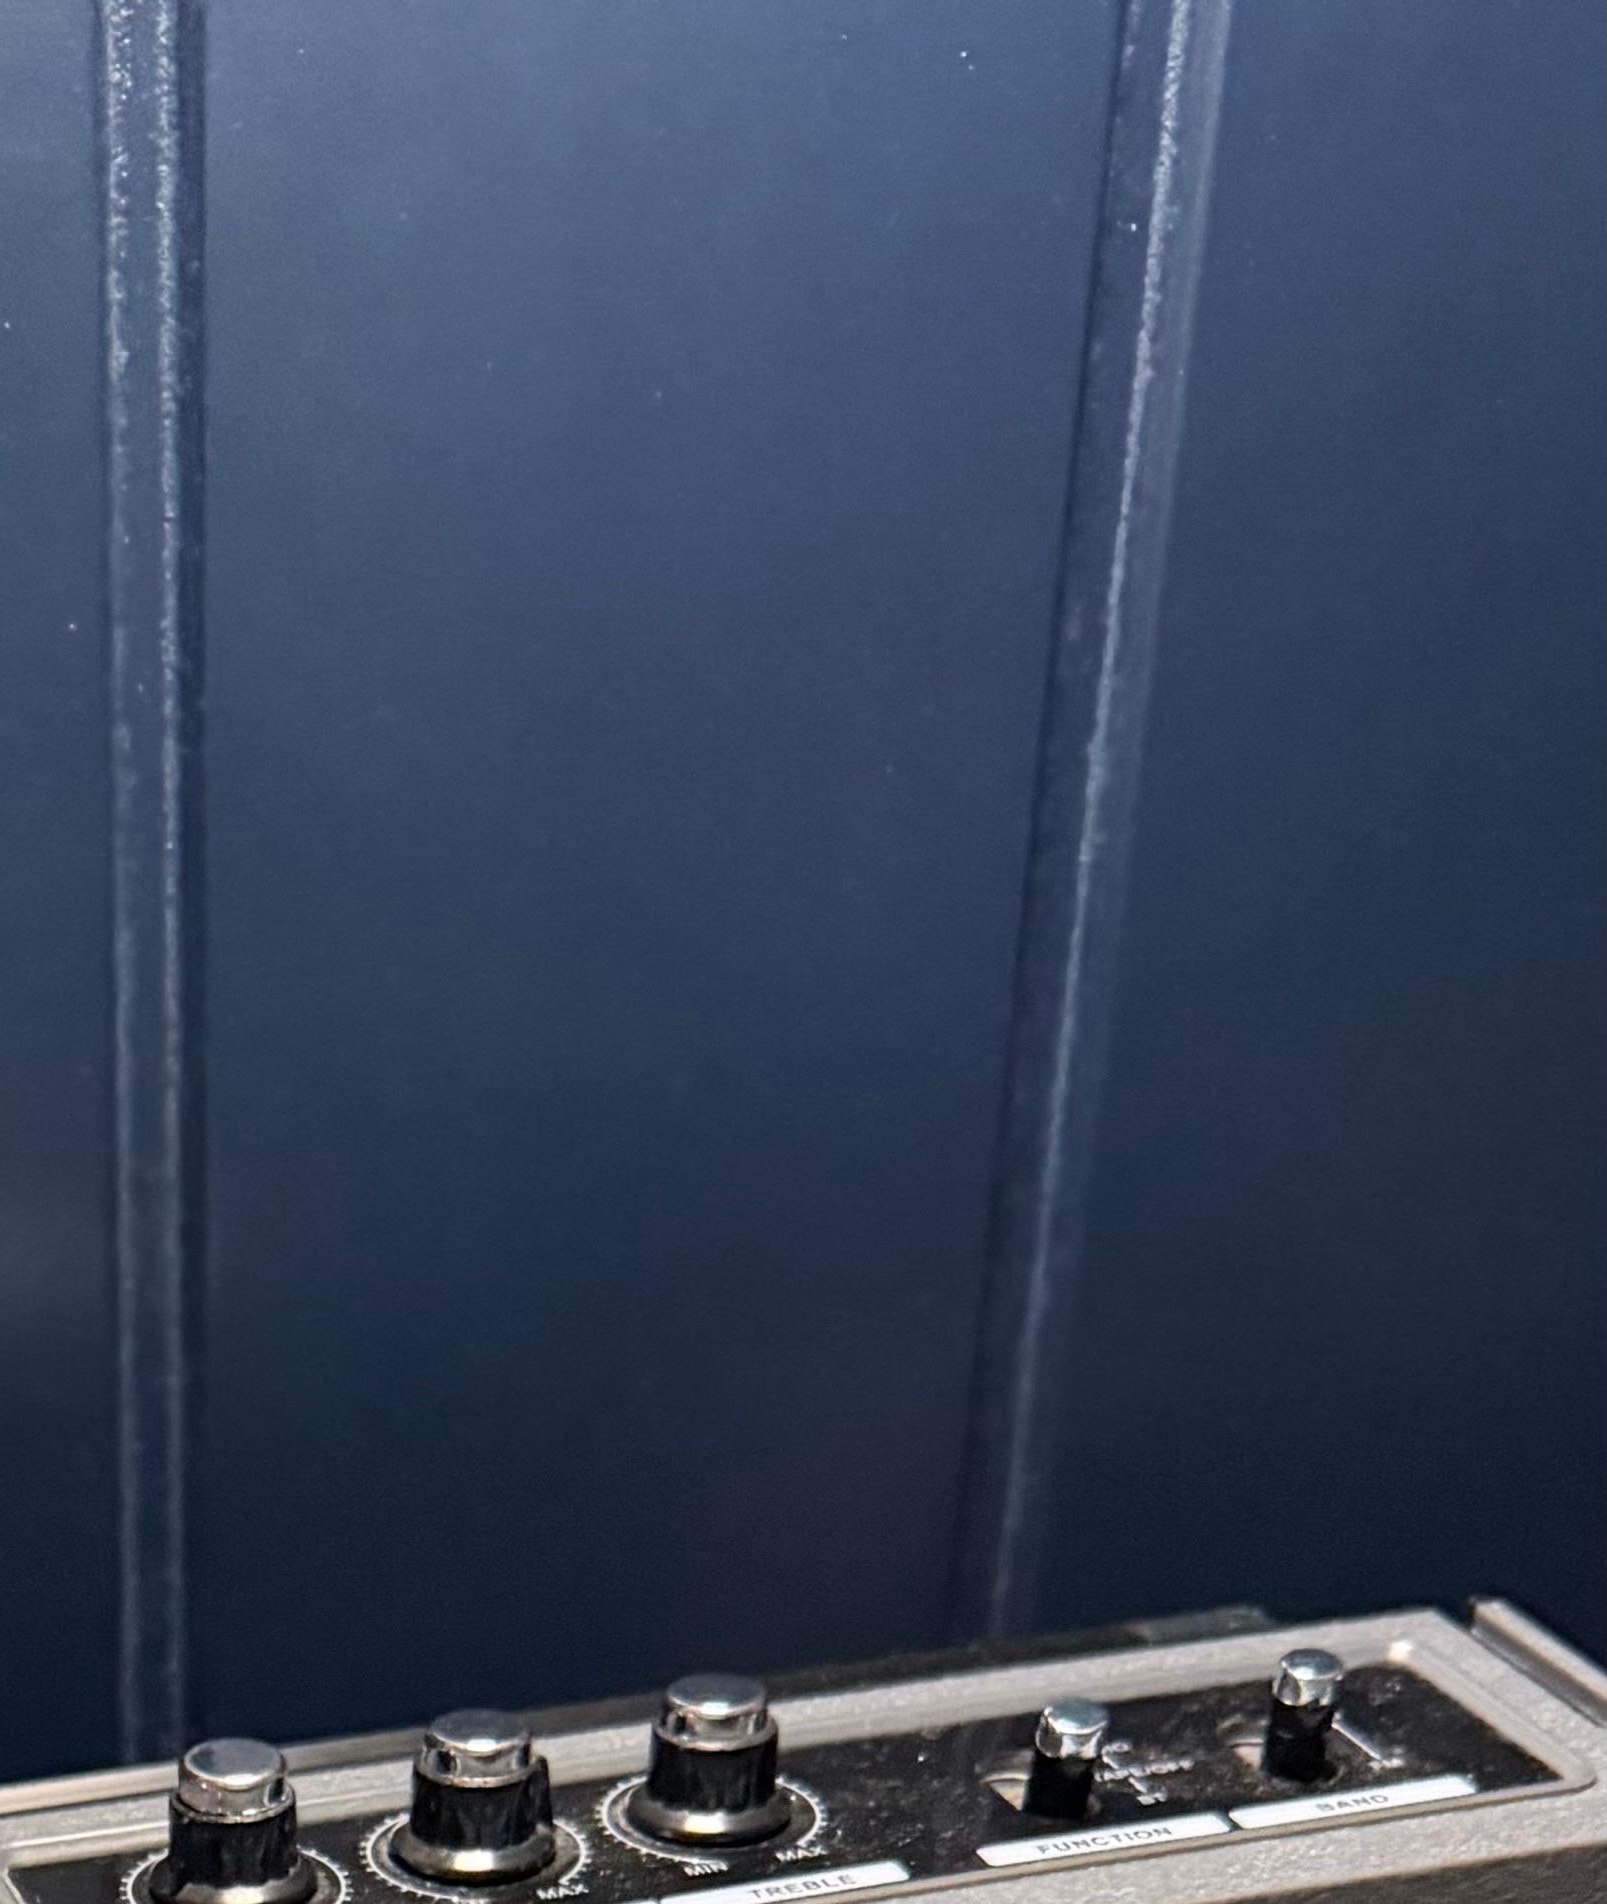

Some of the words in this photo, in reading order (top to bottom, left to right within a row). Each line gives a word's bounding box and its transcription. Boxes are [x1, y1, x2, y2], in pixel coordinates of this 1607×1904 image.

[1316, 1793, 1390, 1814] BAND
[1036, 1827, 1174, 1855] FUNCTION
[775, 1845, 828, 1862] MAX
[683, 1860, 730, 1877] MIN
[536, 1882, 590, 1900] MAX
[745, 1873, 857, 1900] TREBLE
